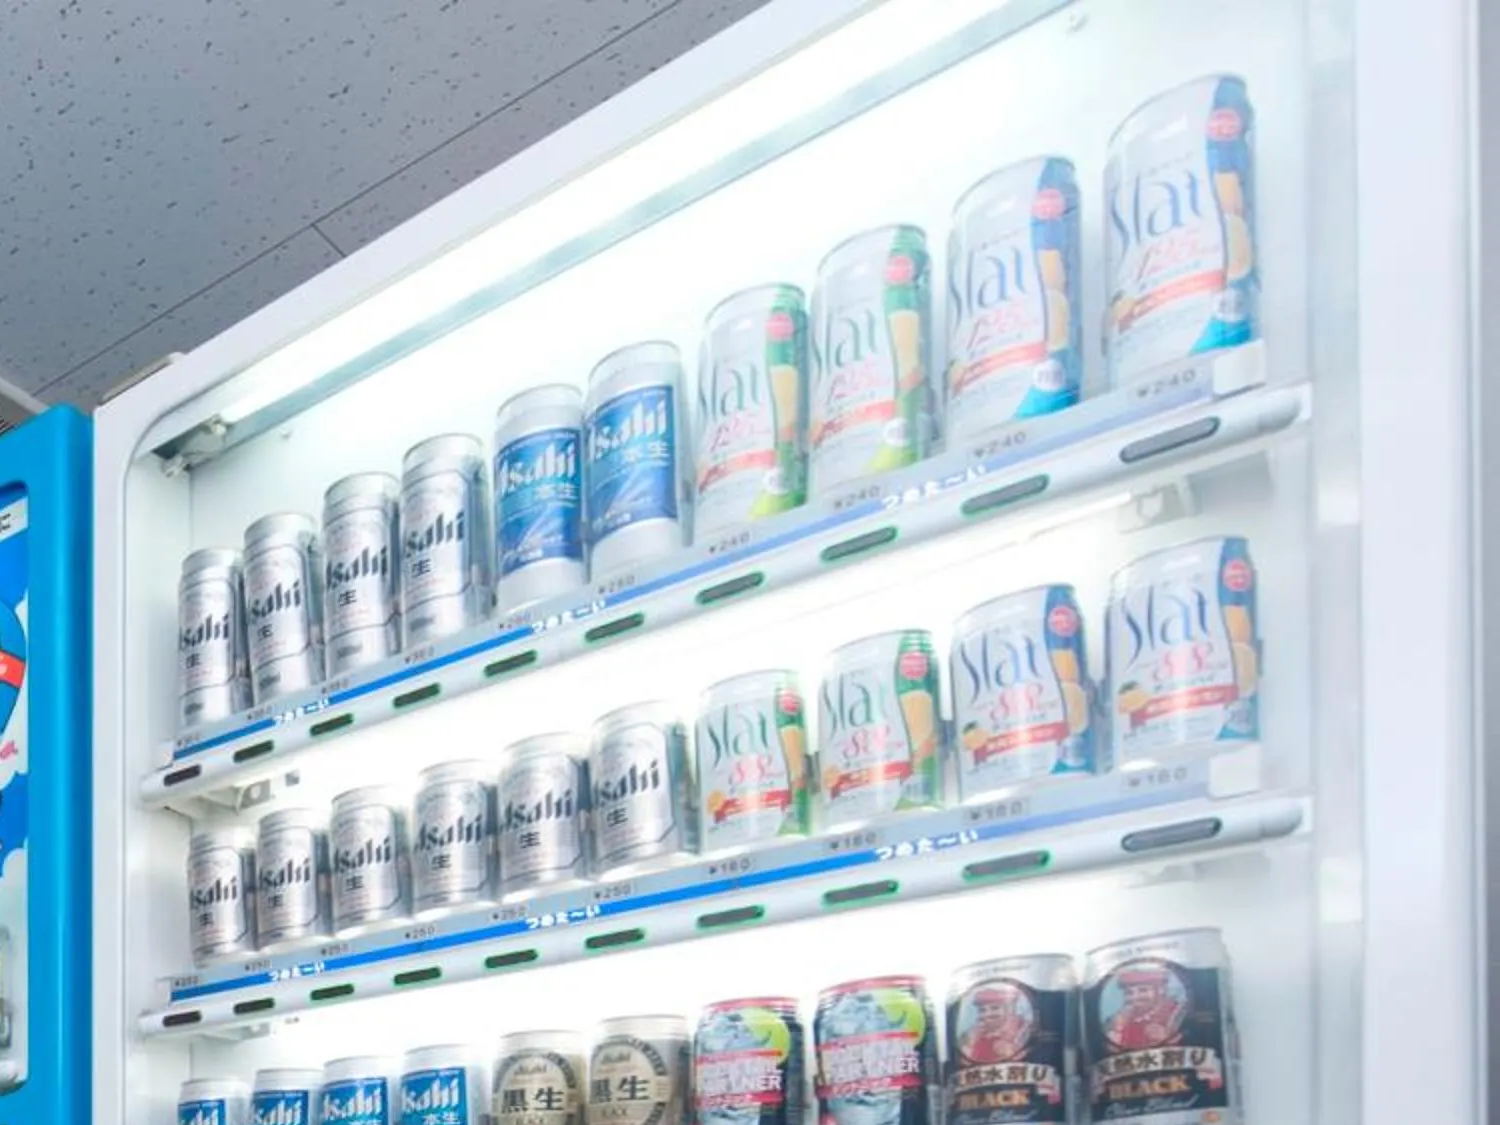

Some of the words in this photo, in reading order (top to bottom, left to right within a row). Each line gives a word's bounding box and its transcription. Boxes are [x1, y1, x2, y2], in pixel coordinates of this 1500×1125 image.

[406, 511, 465, 558] sahi
[251, 581, 301, 618] sahi
[182, 613, 229, 647] sahi
[259, 857, 311, 891] sahi
[191, 875, 238, 909] sahi
[590, 1075, 650, 1105] 黒生
[957, 1064, 1048, 1087] 然水割り
[502, 1086, 565, 1114] 黒生
